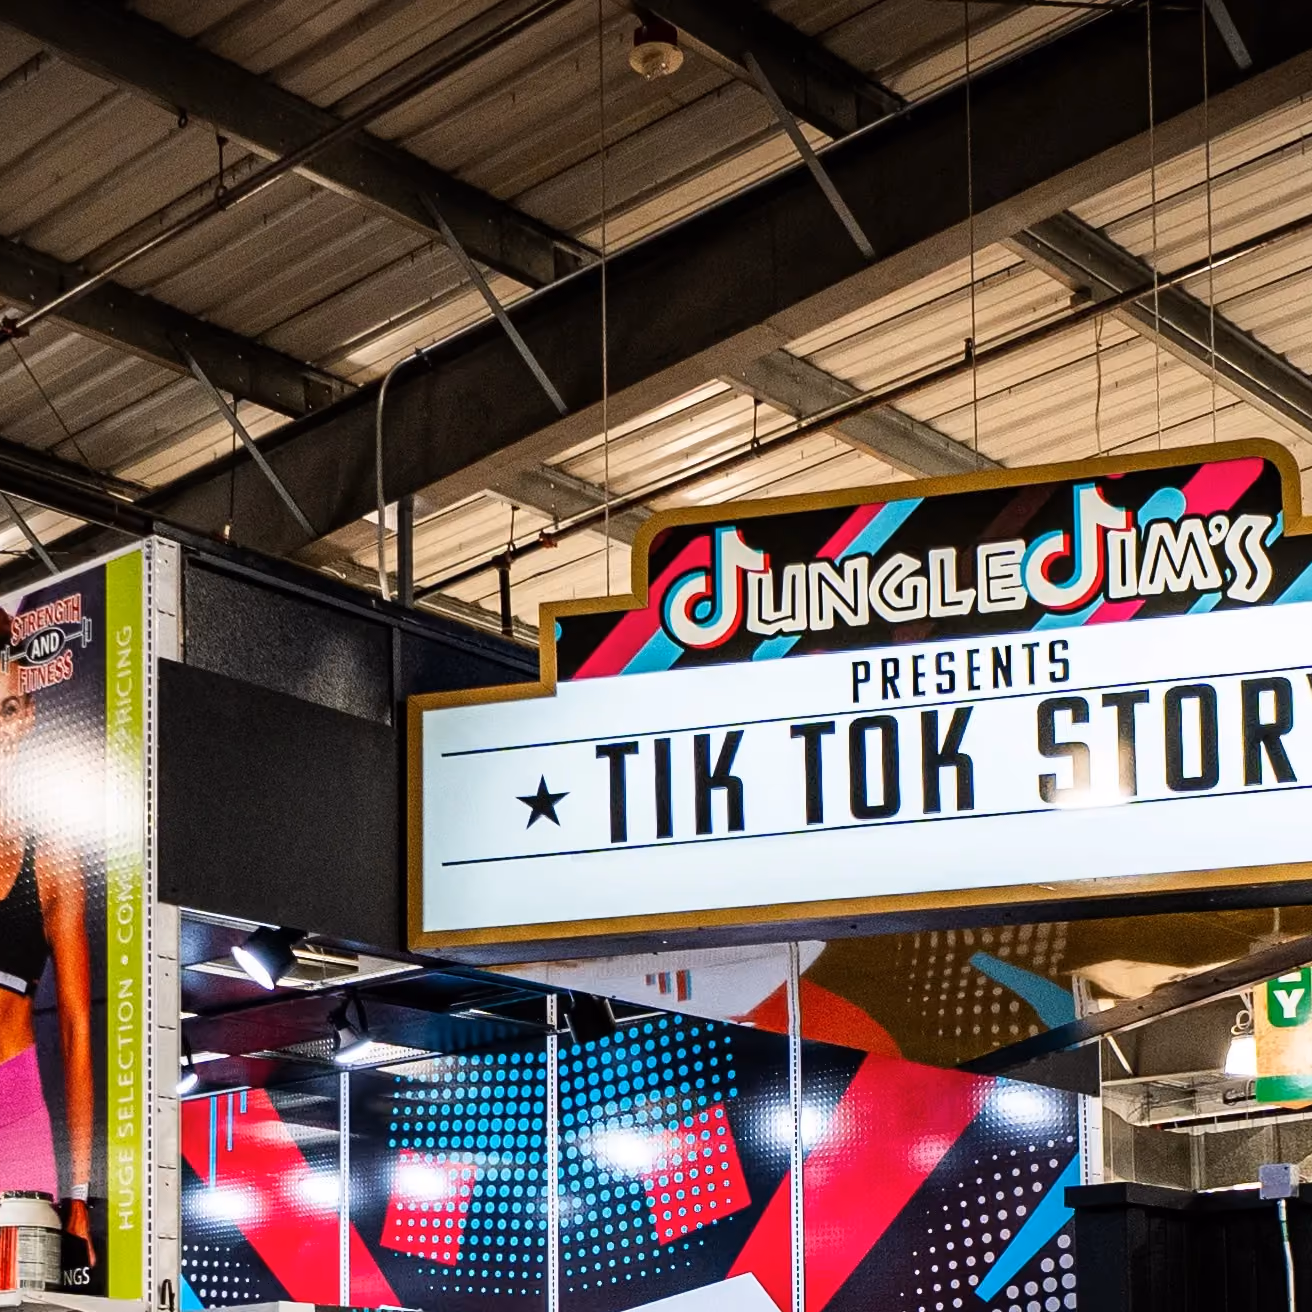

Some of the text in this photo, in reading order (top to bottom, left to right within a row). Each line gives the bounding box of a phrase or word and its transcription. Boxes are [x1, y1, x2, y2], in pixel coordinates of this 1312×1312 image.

[10, 593, 82, 646] STRENGTH
[31, 632, 60, 662] AND
[18, 649, 74, 696] FITNESS
[851, 640, 1070, 703] PRESENTS
[595, 730, 745, 844] TIK
[789, 708, 976, 827] TOK
[118, 978, 134, 1137] SELECTION
[118, 1148, 134, 1229] HUGE
